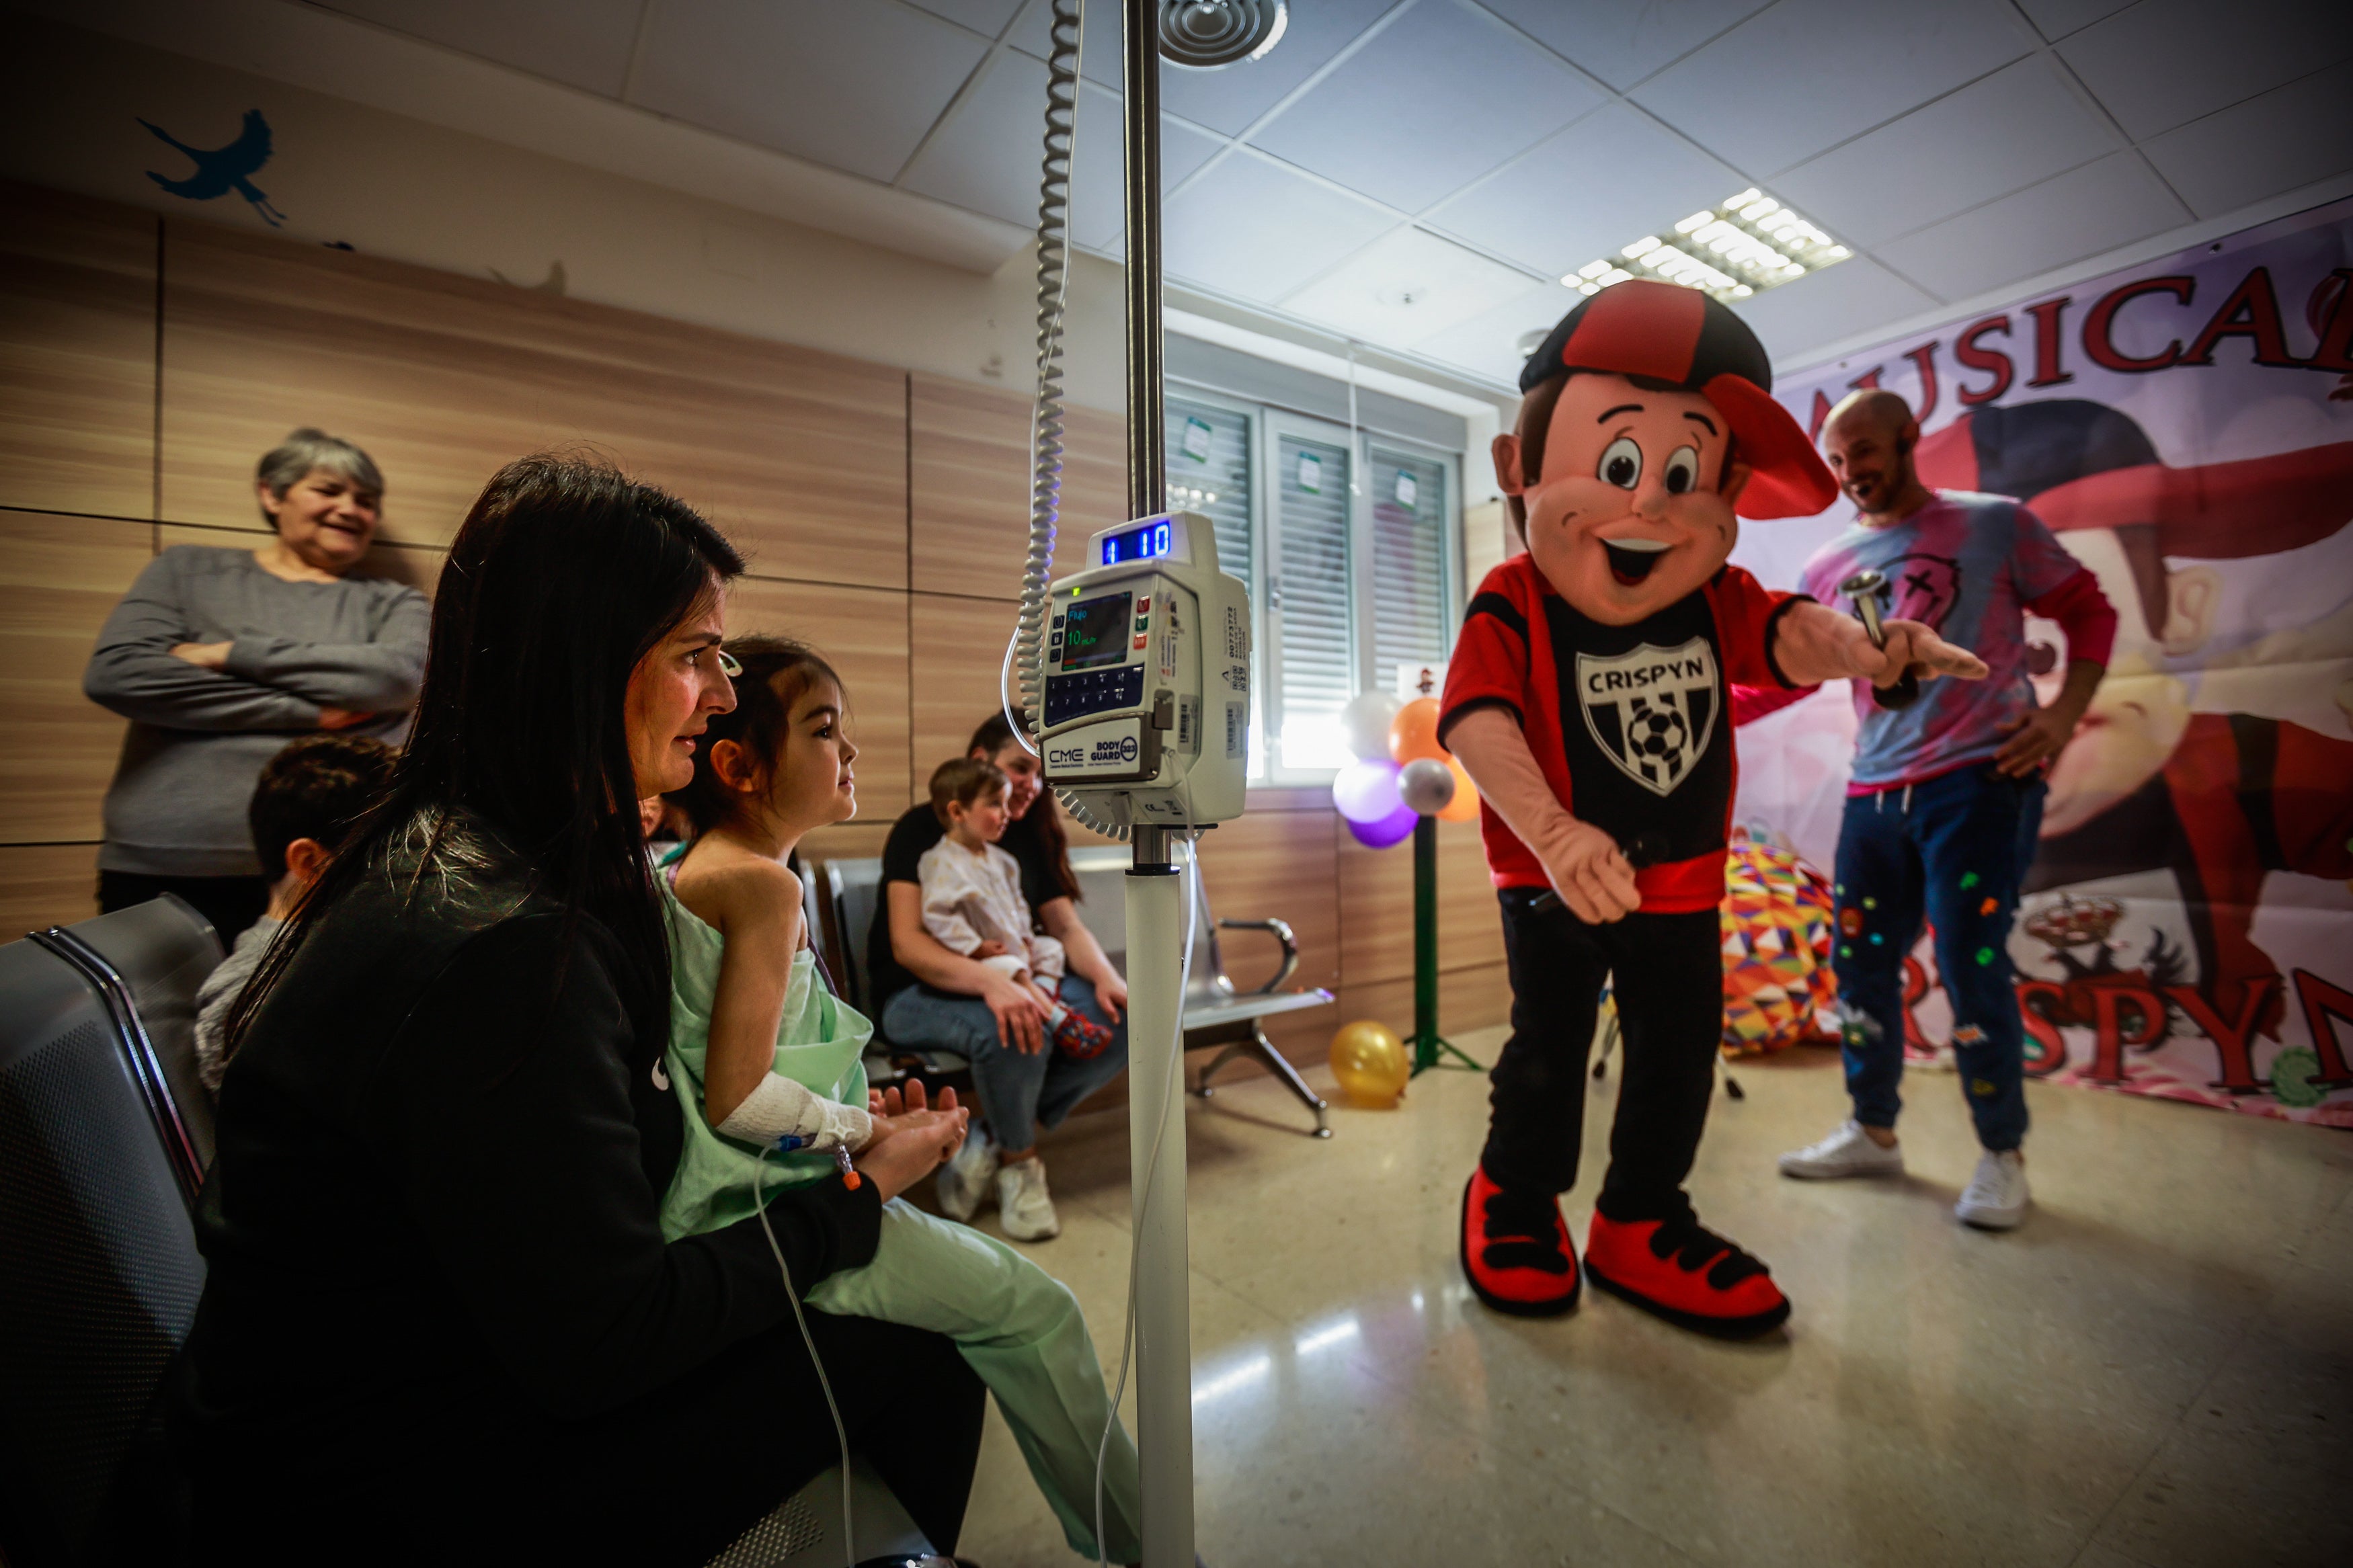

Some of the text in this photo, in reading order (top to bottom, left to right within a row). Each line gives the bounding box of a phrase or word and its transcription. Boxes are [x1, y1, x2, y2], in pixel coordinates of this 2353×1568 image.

[1808, 266, 2353, 449] USICA
[1142, 524, 1169, 556] 10
[1068, 630, 1081, 645] 10
[1589, 657, 1704, 693] CRISPYN
[1096, 741, 1120, 751] BODY
[1049, 749, 1084, 762] CME
[1090, 751, 1121, 761] GUARD
